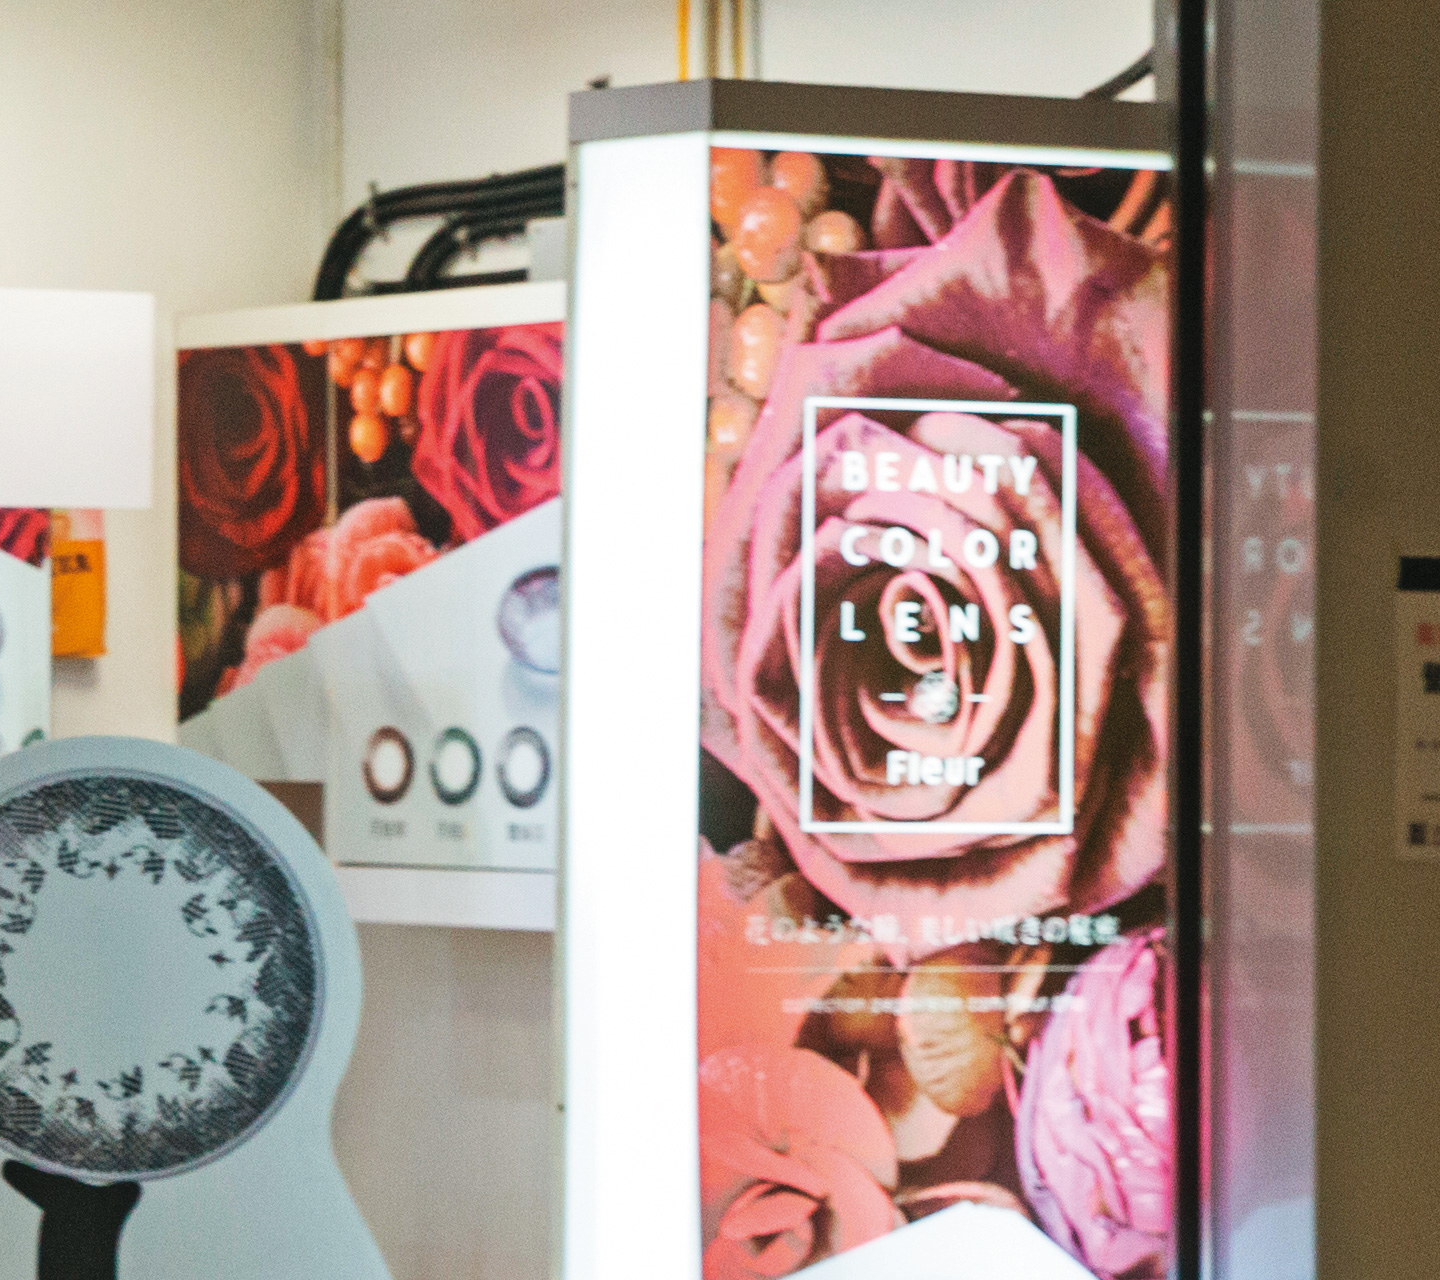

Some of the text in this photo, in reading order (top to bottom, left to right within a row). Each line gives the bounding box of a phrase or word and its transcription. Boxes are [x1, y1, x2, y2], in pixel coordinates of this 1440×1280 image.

[840, 449, 1039, 497] BEAUTY
[840, 524, 1040, 571] COLOR
[839, 599, 1038, 645] LENS
[886, 749, 986, 788] Fleur
